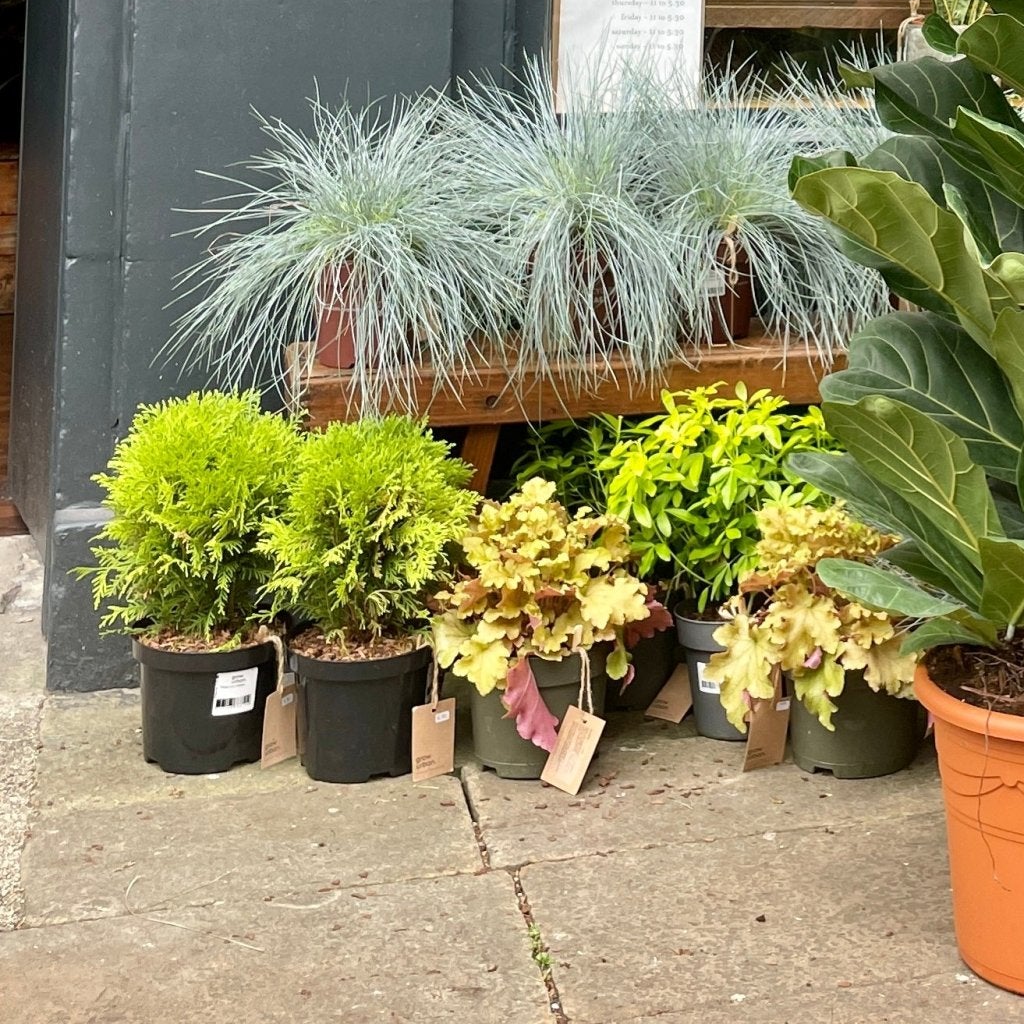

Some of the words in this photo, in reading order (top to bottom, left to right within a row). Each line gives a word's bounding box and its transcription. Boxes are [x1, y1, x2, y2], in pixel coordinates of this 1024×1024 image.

[668, 0, 685, 8] 5.30
[621, 12, 641, 23] friday
[667, 14, 685, 22] 5.30
[612, 27, 641, 36] saturday
[667, 29, 684, 37] 5.30
